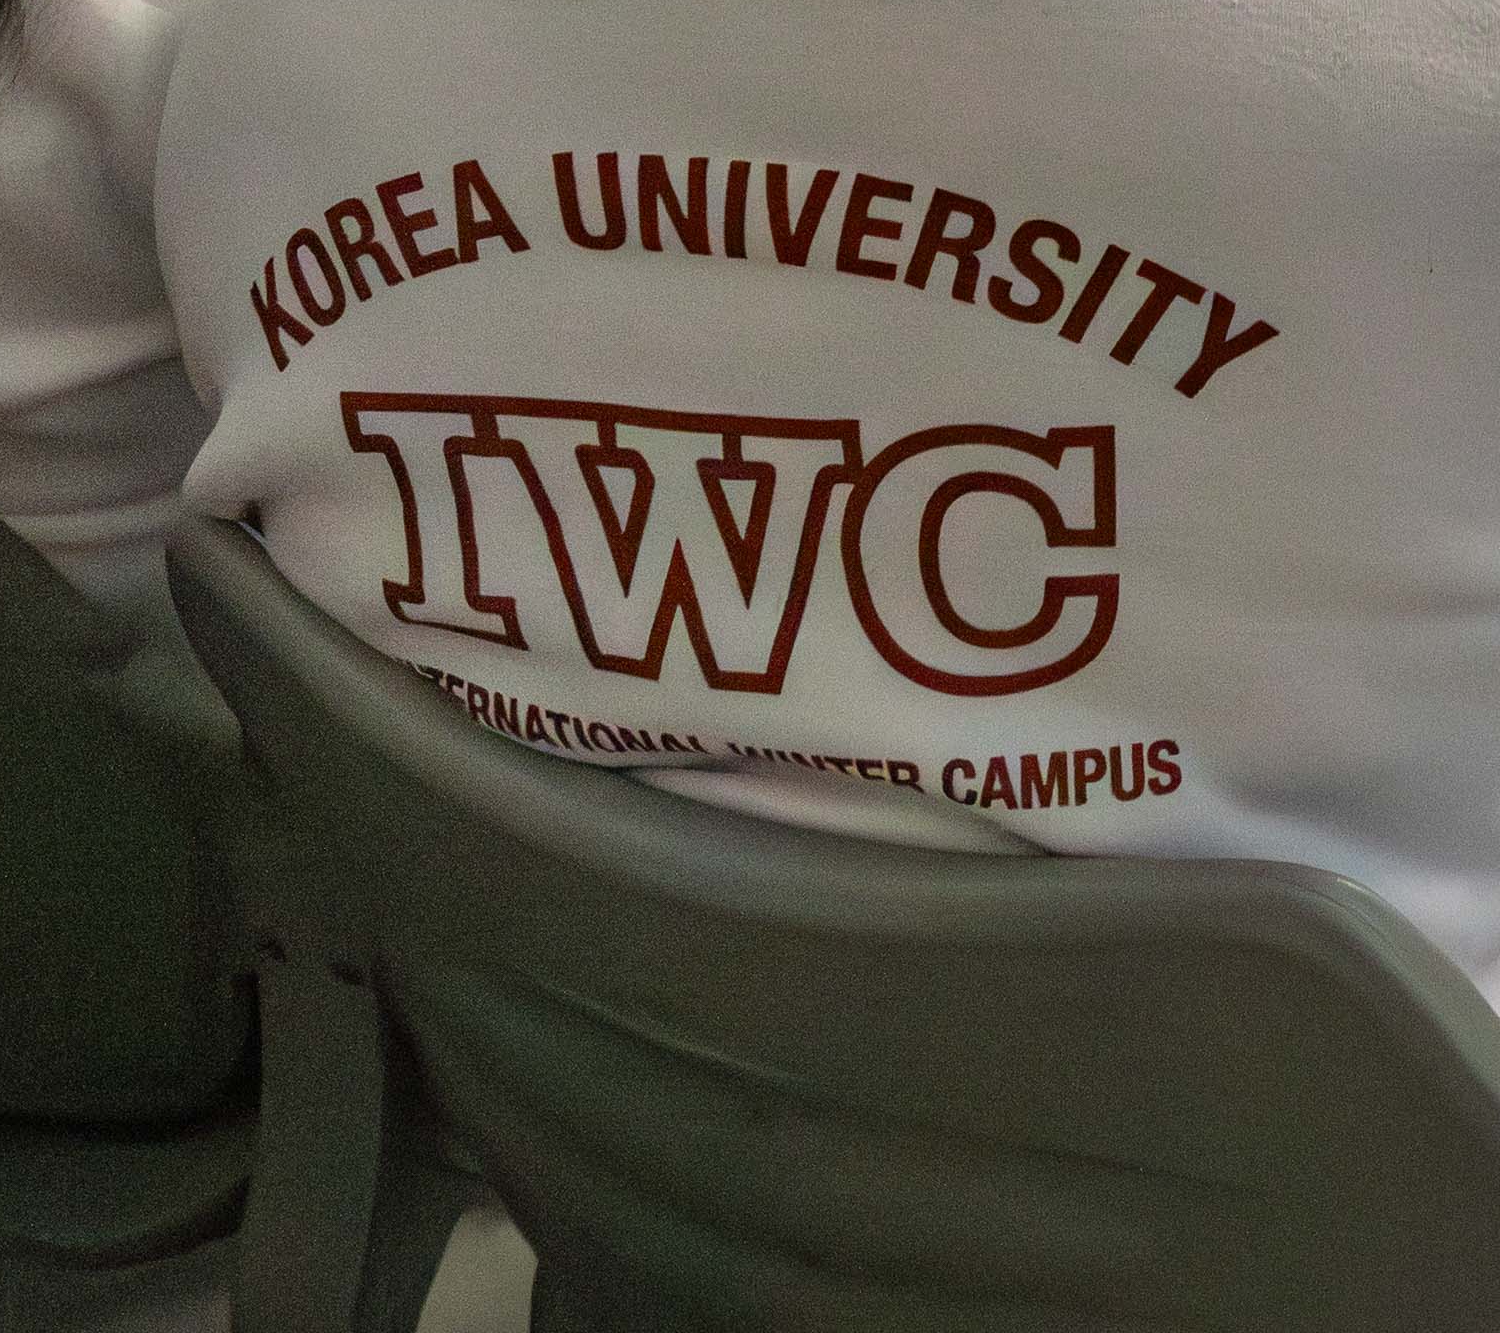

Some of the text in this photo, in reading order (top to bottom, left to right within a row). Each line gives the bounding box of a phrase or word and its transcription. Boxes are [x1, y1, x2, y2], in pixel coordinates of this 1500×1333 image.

[248, 150, 1282, 400] KOREA UNIVERSITY
[339, 390, 1120, 697] IWC
[941, 738, 1184, 811] CAMPUS
